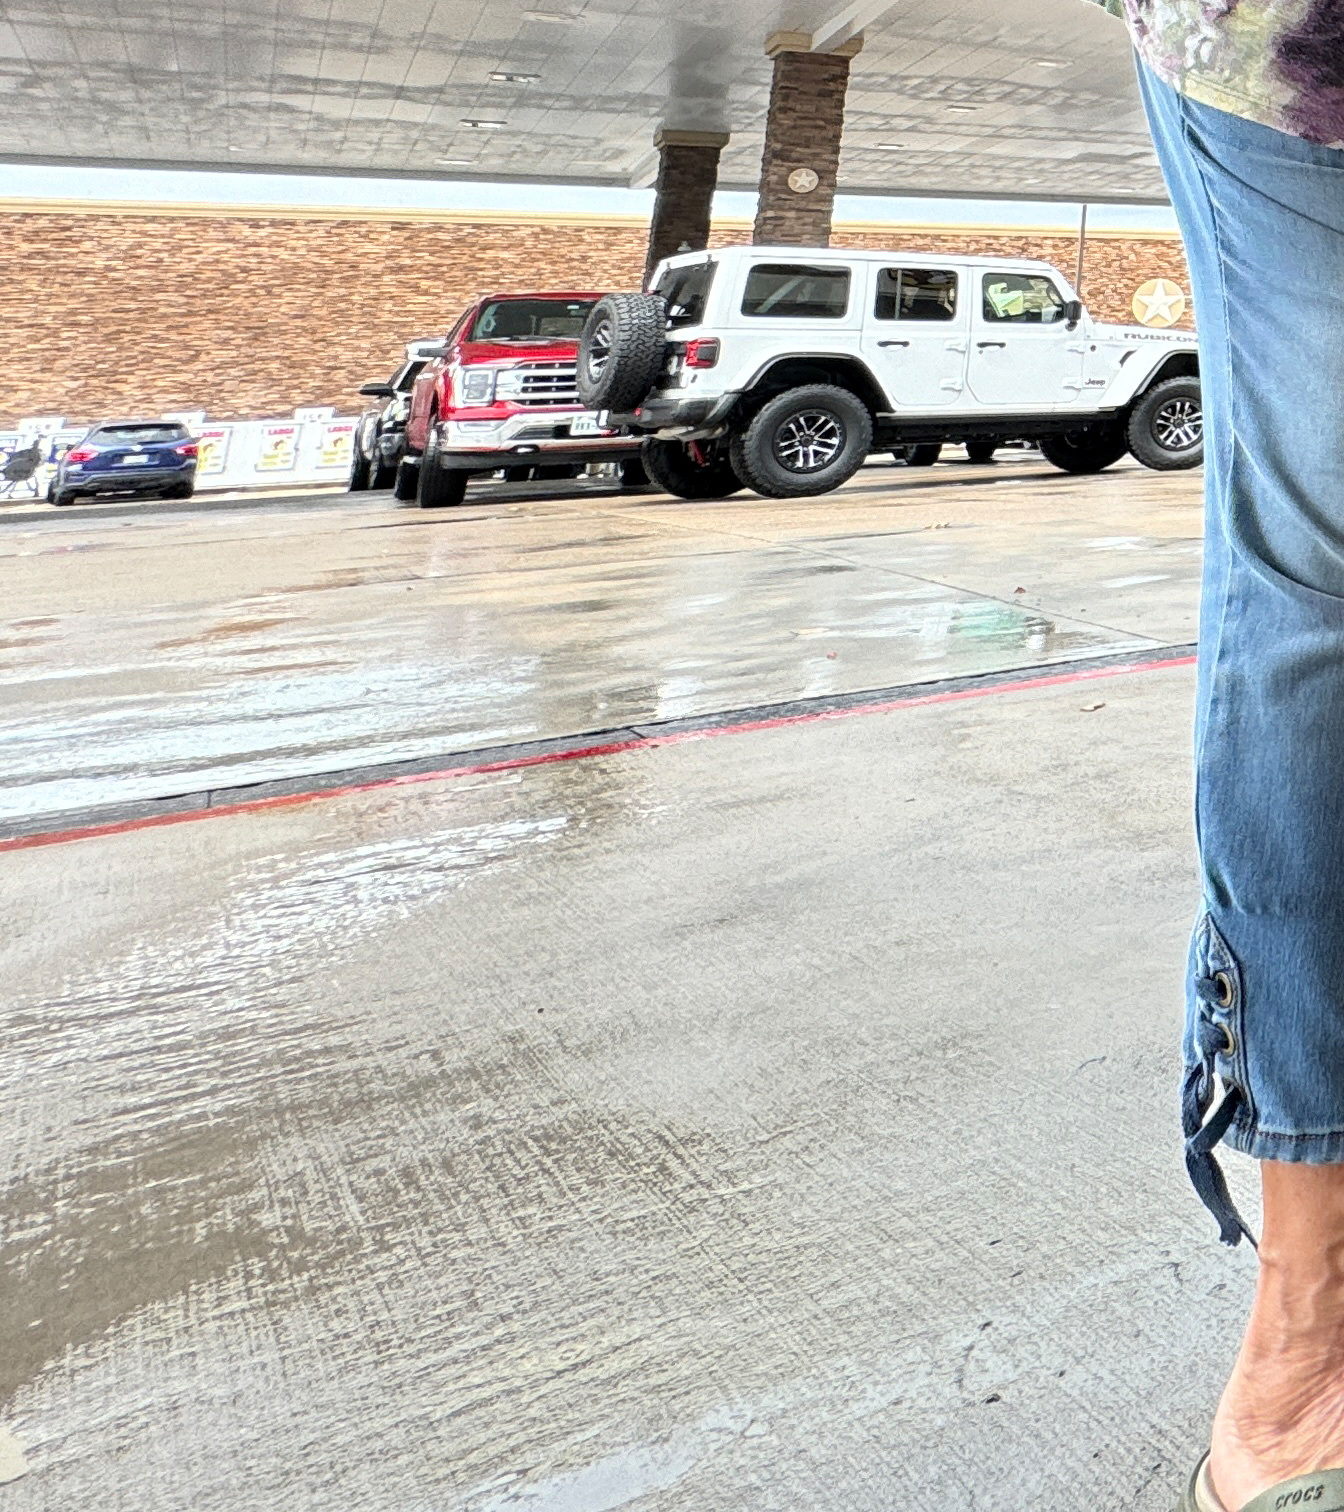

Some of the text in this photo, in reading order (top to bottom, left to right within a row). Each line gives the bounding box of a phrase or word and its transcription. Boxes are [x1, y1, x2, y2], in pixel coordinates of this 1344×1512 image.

[1124, 333, 1198, 343] RUBICON
[1085, 378, 1106, 386] Jeep
[1275, 1484, 1325, 1511] crocs
